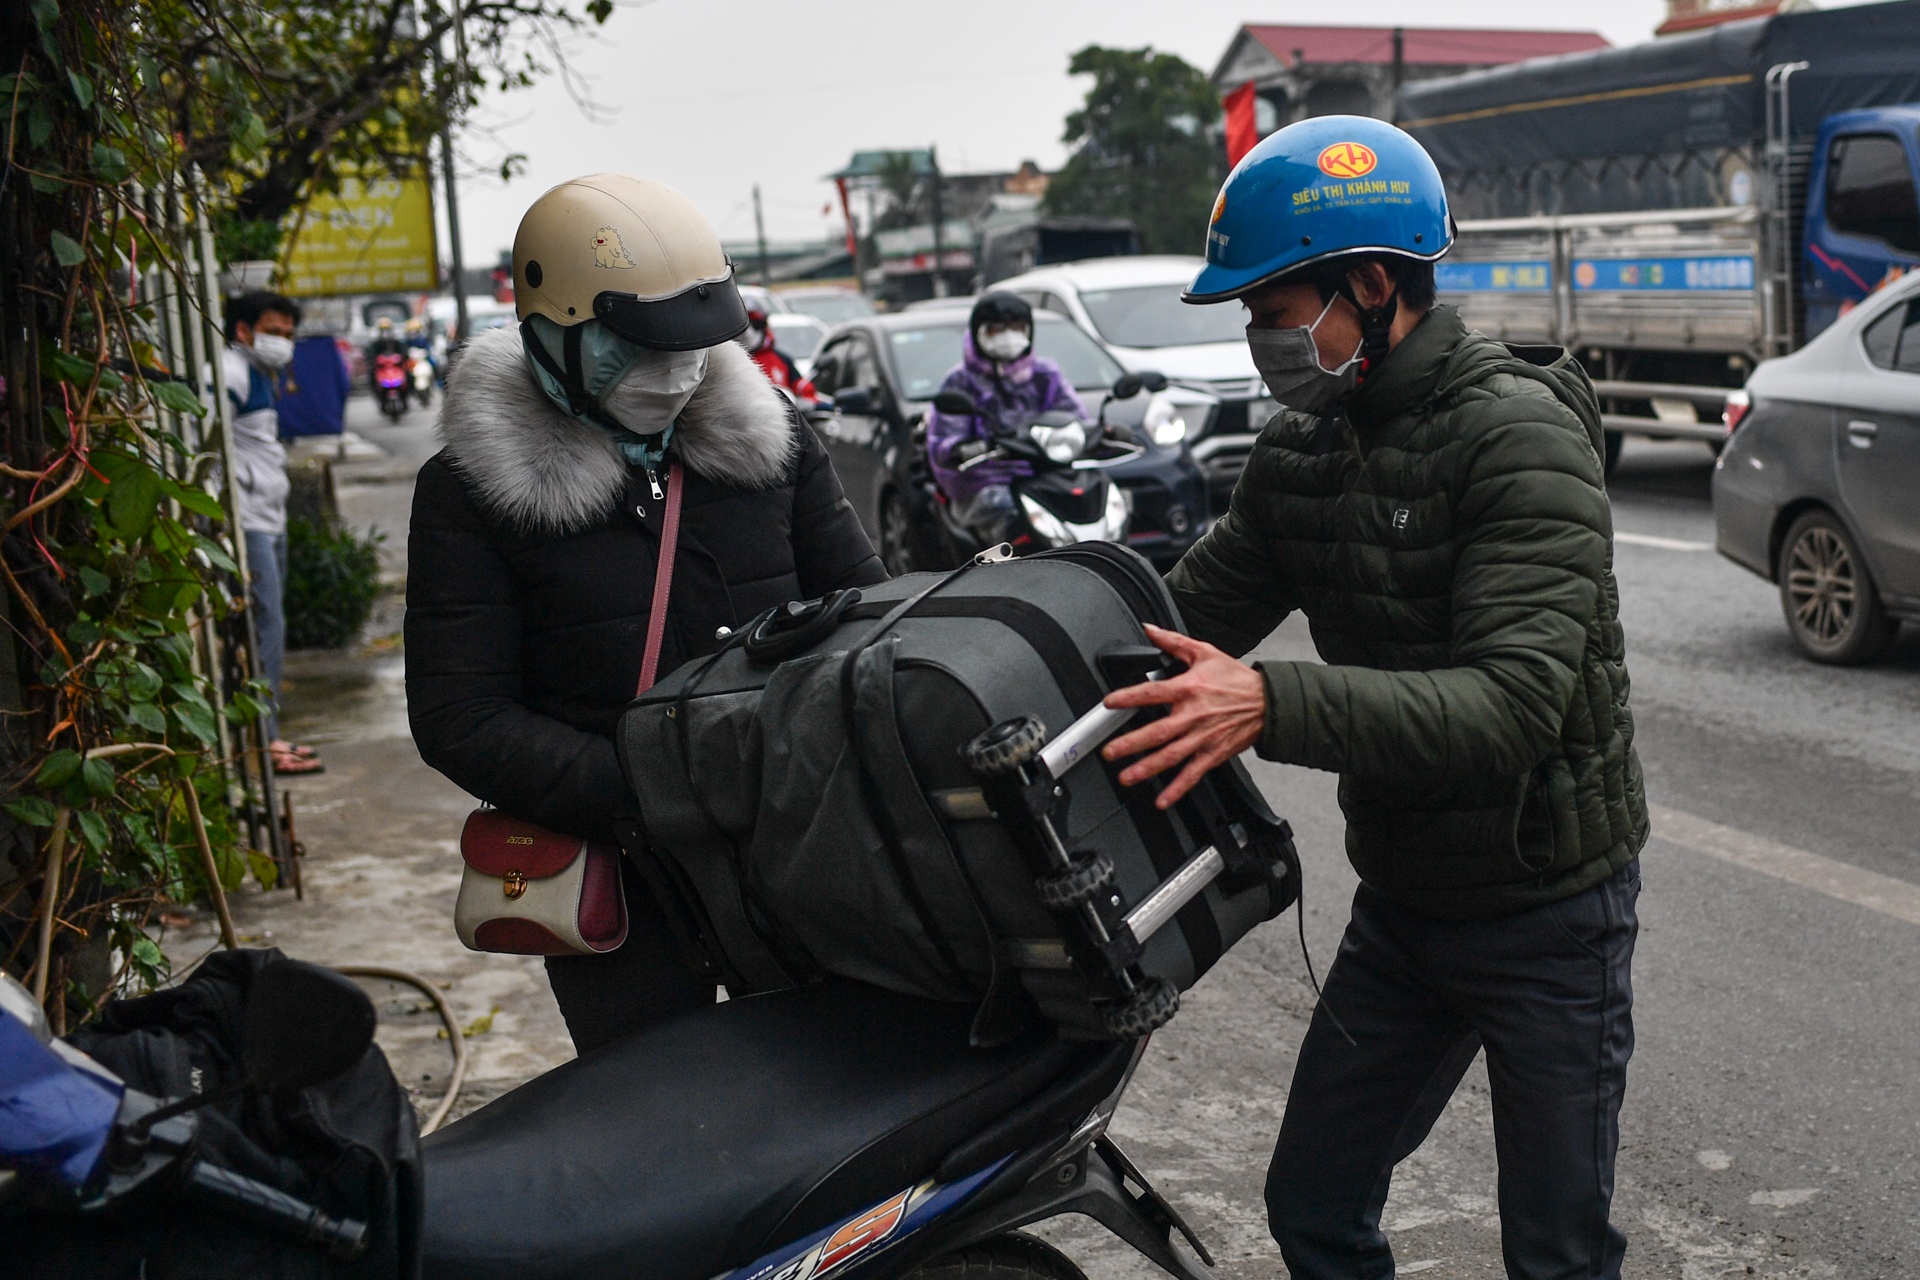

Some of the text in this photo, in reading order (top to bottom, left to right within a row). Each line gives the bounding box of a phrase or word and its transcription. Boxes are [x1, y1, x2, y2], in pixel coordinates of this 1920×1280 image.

[1322, 143, 1372, 176] KH
[1292, 178, 1410, 206] SIÊU THỊ KHÁNH HUY
